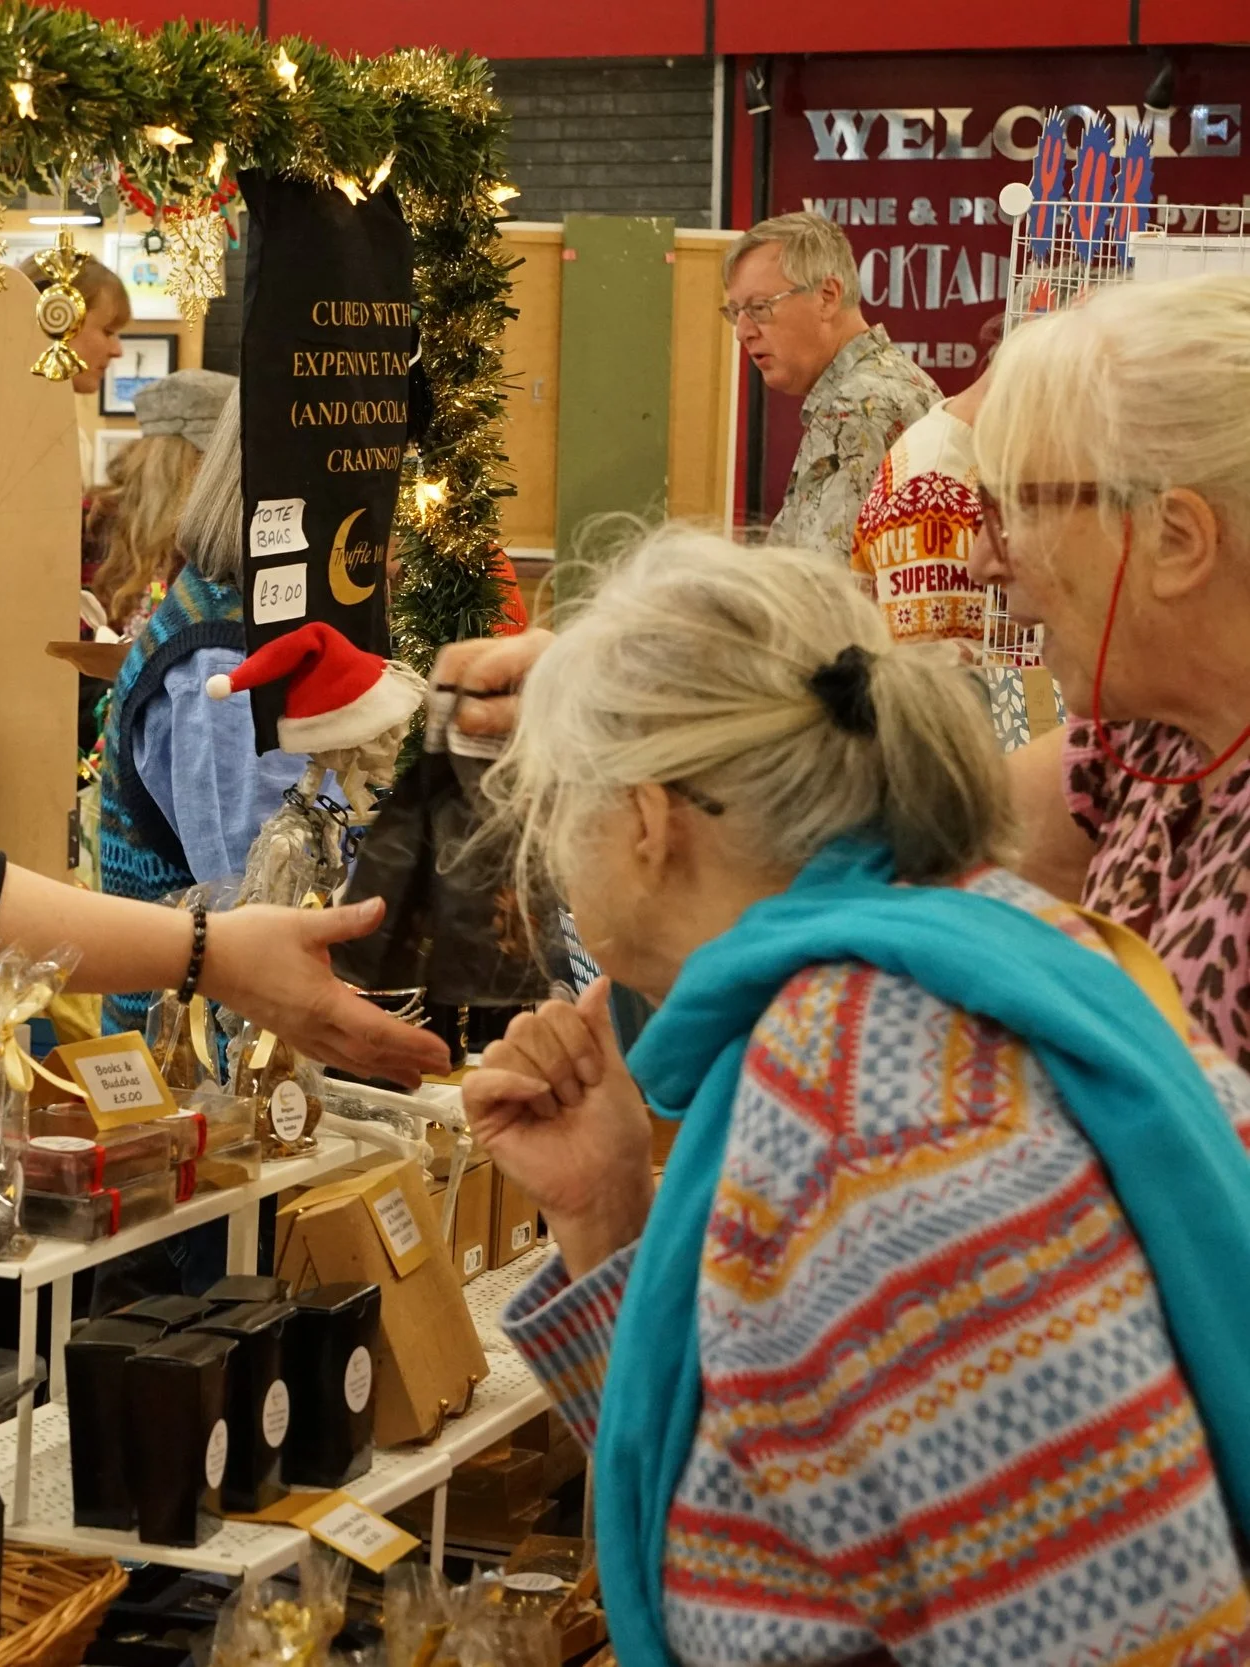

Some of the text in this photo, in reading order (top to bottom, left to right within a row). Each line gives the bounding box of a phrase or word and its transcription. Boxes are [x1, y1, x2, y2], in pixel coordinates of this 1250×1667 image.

[804, 104, 1241, 161] WELCOME
[908, 196, 938, 226] &
[1157, 195, 1202, 232] by
[859, 243, 1010, 311] CKTAI
[313, 301, 411, 328] CURED WITH
[381, 351, 410, 377] TAS
[291, 400, 348, 429] (AND
[253, 505, 294, 524] TOTE
[256, 528, 292, 548] BAGS
[923, 520, 953, 555] UP
[260, 580, 302, 607] £3.00
[94, 1063, 122, 1076] Books
[101, 1076, 140, 1090] Buddhas
[113, 1091, 143, 1104] £5.00
